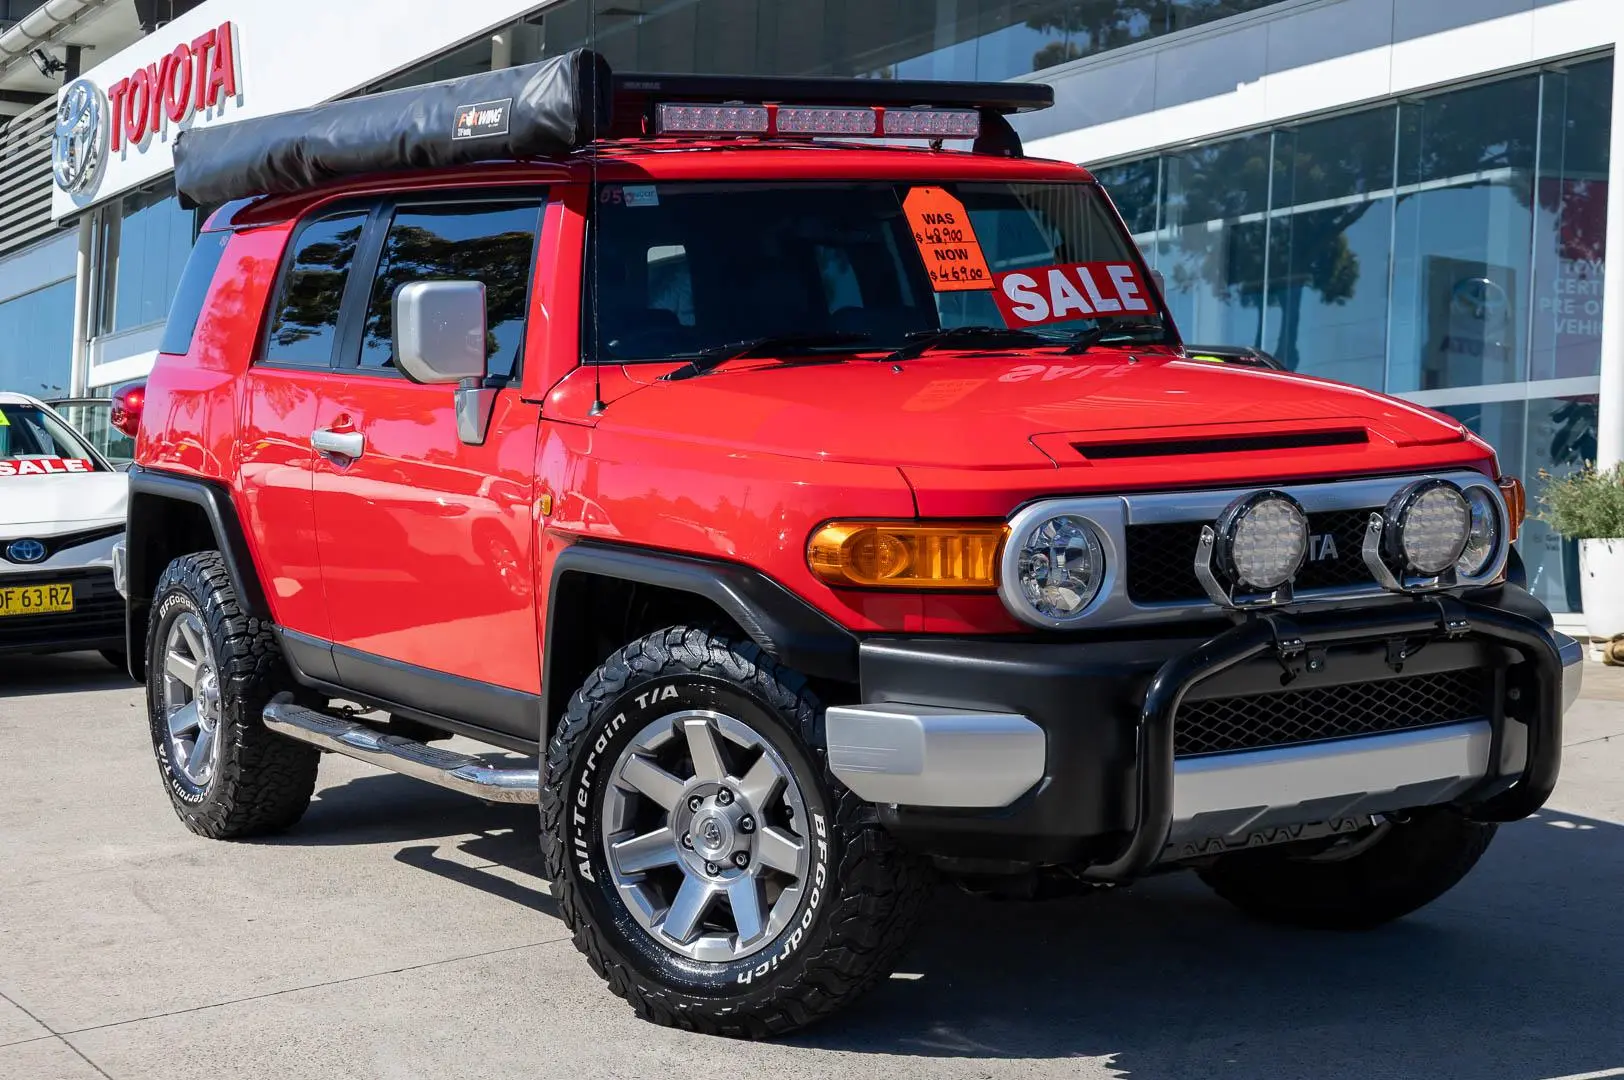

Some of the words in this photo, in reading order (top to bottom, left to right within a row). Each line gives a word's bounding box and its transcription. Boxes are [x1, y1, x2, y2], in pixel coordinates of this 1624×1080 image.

[108, 21, 236, 152] TOYOTA
[921, 213, 955, 225] WAS
[934, 249, 968, 261] NOW
[1560, 257, 1605, 275] TOY
[1002, 265, 1148, 322] SALE
[0, 459, 88, 476] SALE
[572, 712, 627, 883] All-Terrain
[635, 684, 679, 711] T/A
[737, 813, 828, 985] BFGoodrich
